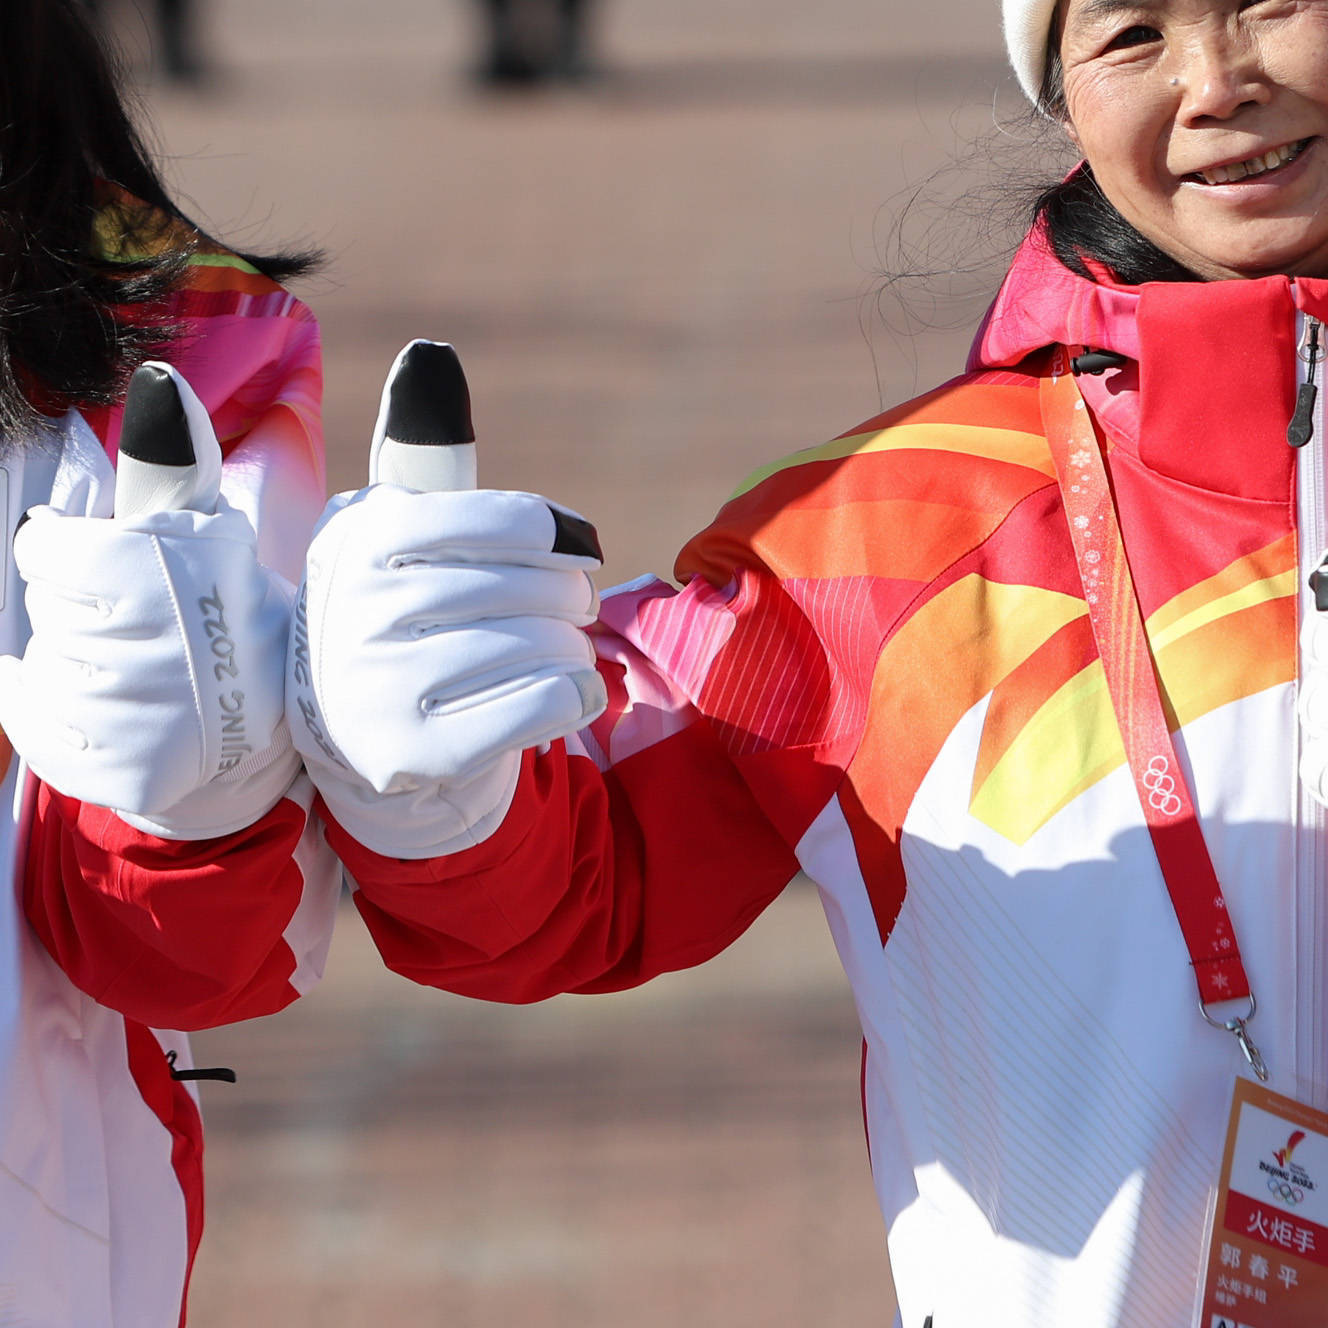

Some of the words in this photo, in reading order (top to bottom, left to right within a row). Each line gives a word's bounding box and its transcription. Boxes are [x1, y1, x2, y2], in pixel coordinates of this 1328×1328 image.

[197, 584, 239, 683] 2022
[213, 689, 253, 779] EIJING
[1247, 1209, 1315, 1253] 火炬手
